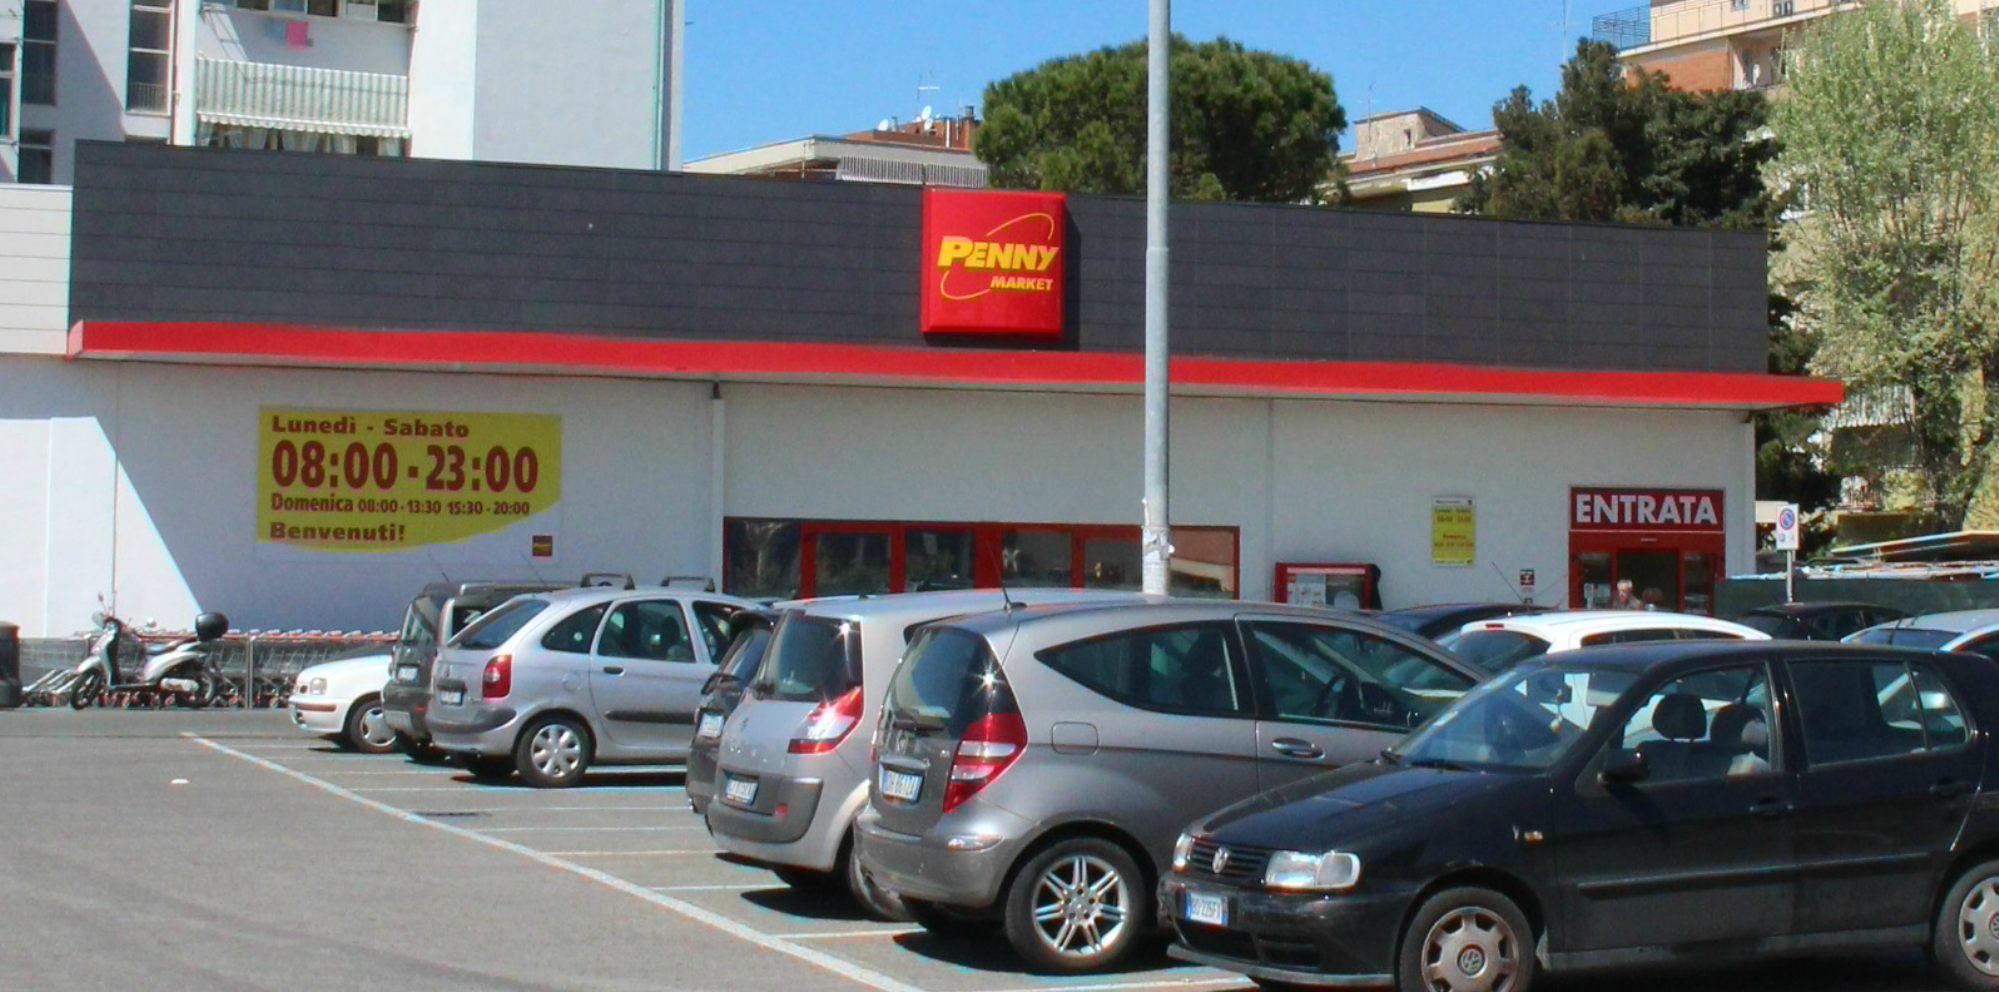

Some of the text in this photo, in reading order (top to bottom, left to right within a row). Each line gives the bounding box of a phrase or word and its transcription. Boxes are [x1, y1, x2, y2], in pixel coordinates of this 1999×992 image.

[937, 235, 1059, 272] PENNY
[990, 275, 1053, 292] MARKET
[384, 418, 469, 438] Sabato
[272, 439, 398, 489] 08:00
[426, 444, 538, 493] 23:00
[271, 493, 353, 512] Domenica
[407, 500, 441, 514] 13:30
[493, 501, 530, 515] 20:00
[1575, 494, 1718, 524] ENTRATA
[270, 522, 405, 542] Benvenuti!
